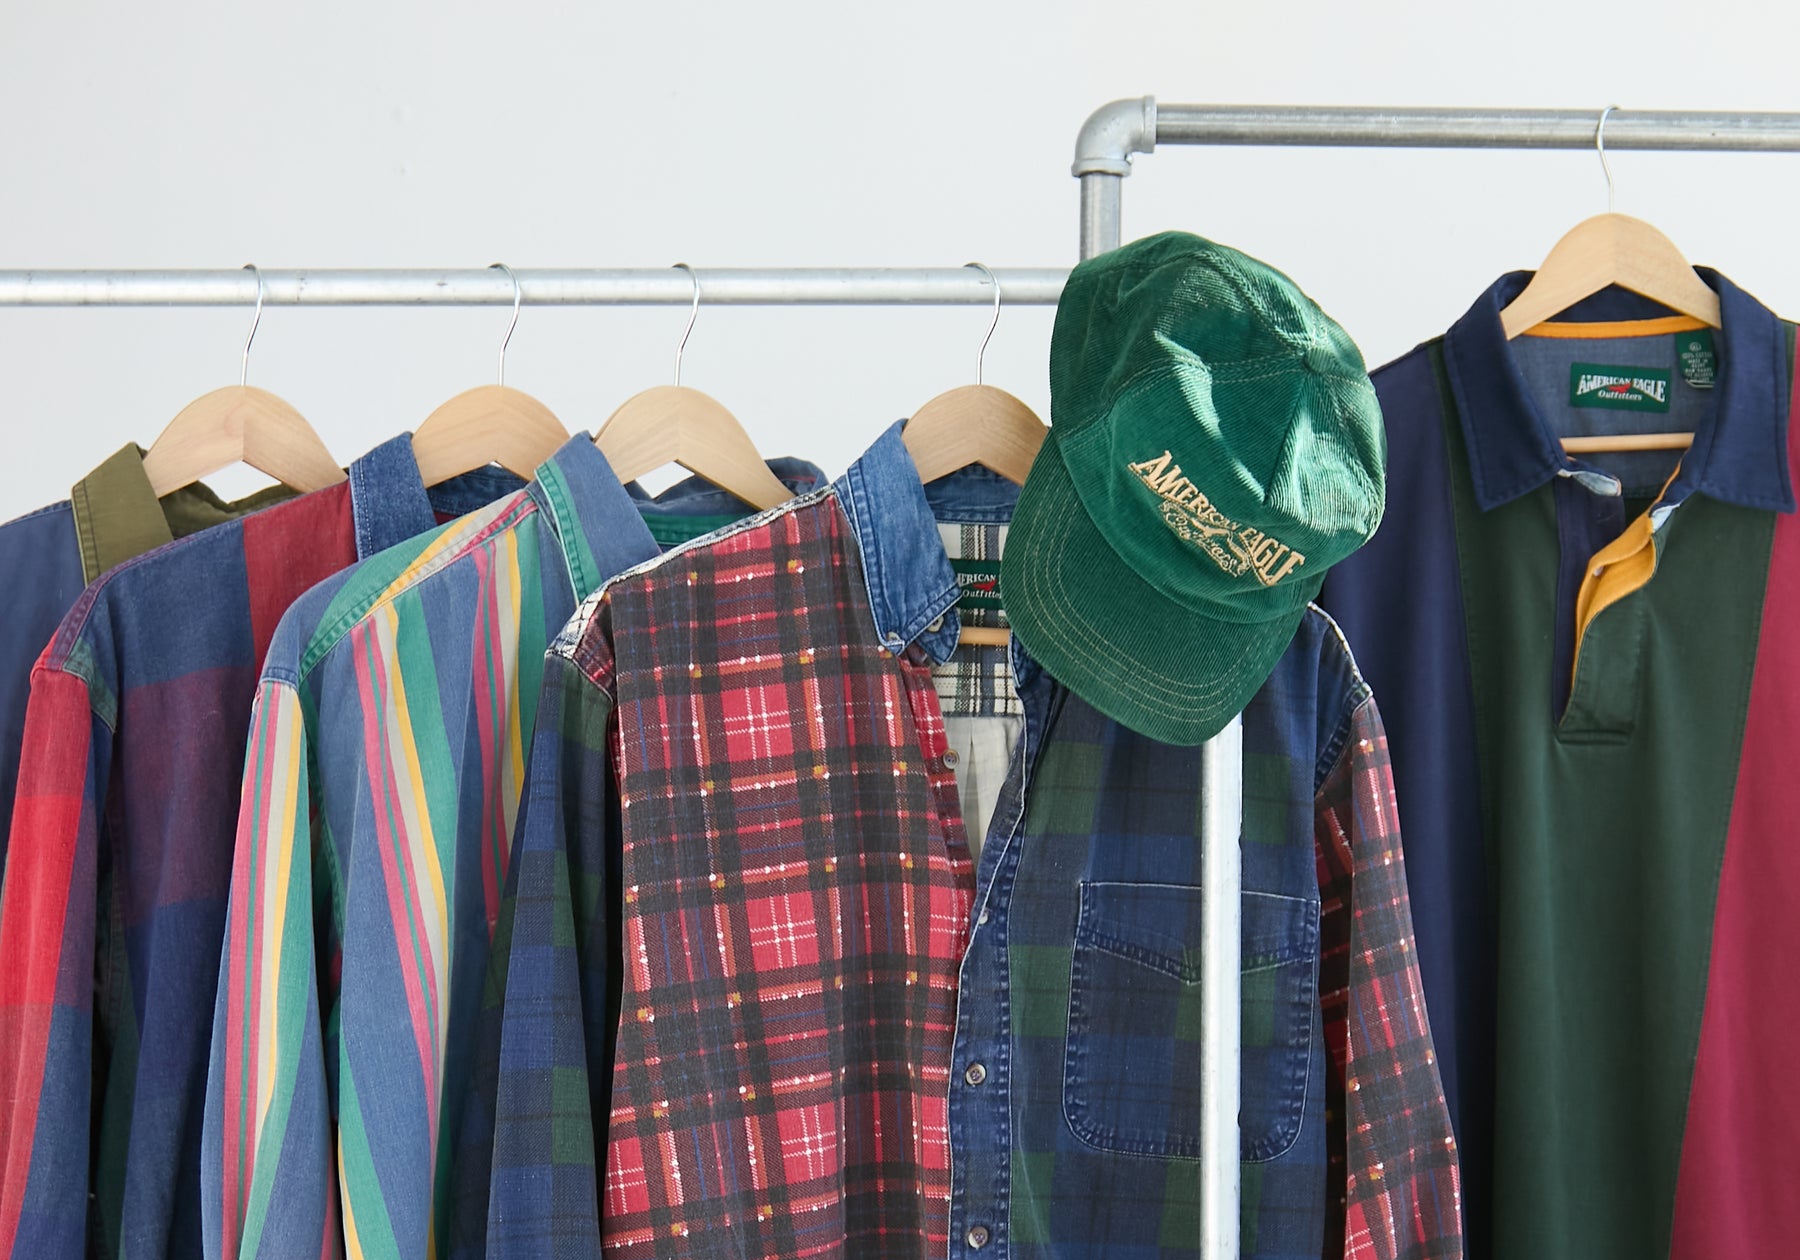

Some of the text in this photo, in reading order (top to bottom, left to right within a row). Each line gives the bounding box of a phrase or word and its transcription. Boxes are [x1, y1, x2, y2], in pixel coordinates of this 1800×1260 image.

[1577, 374, 1666, 402] AMERICAN EAGLE
[1598, 390, 1643, 401] Outfitters
[1128, 450, 1242, 531] AMERICAN
[957, 573, 997, 587] ERICAN
[962, 589, 1001, 599] Outfitte
